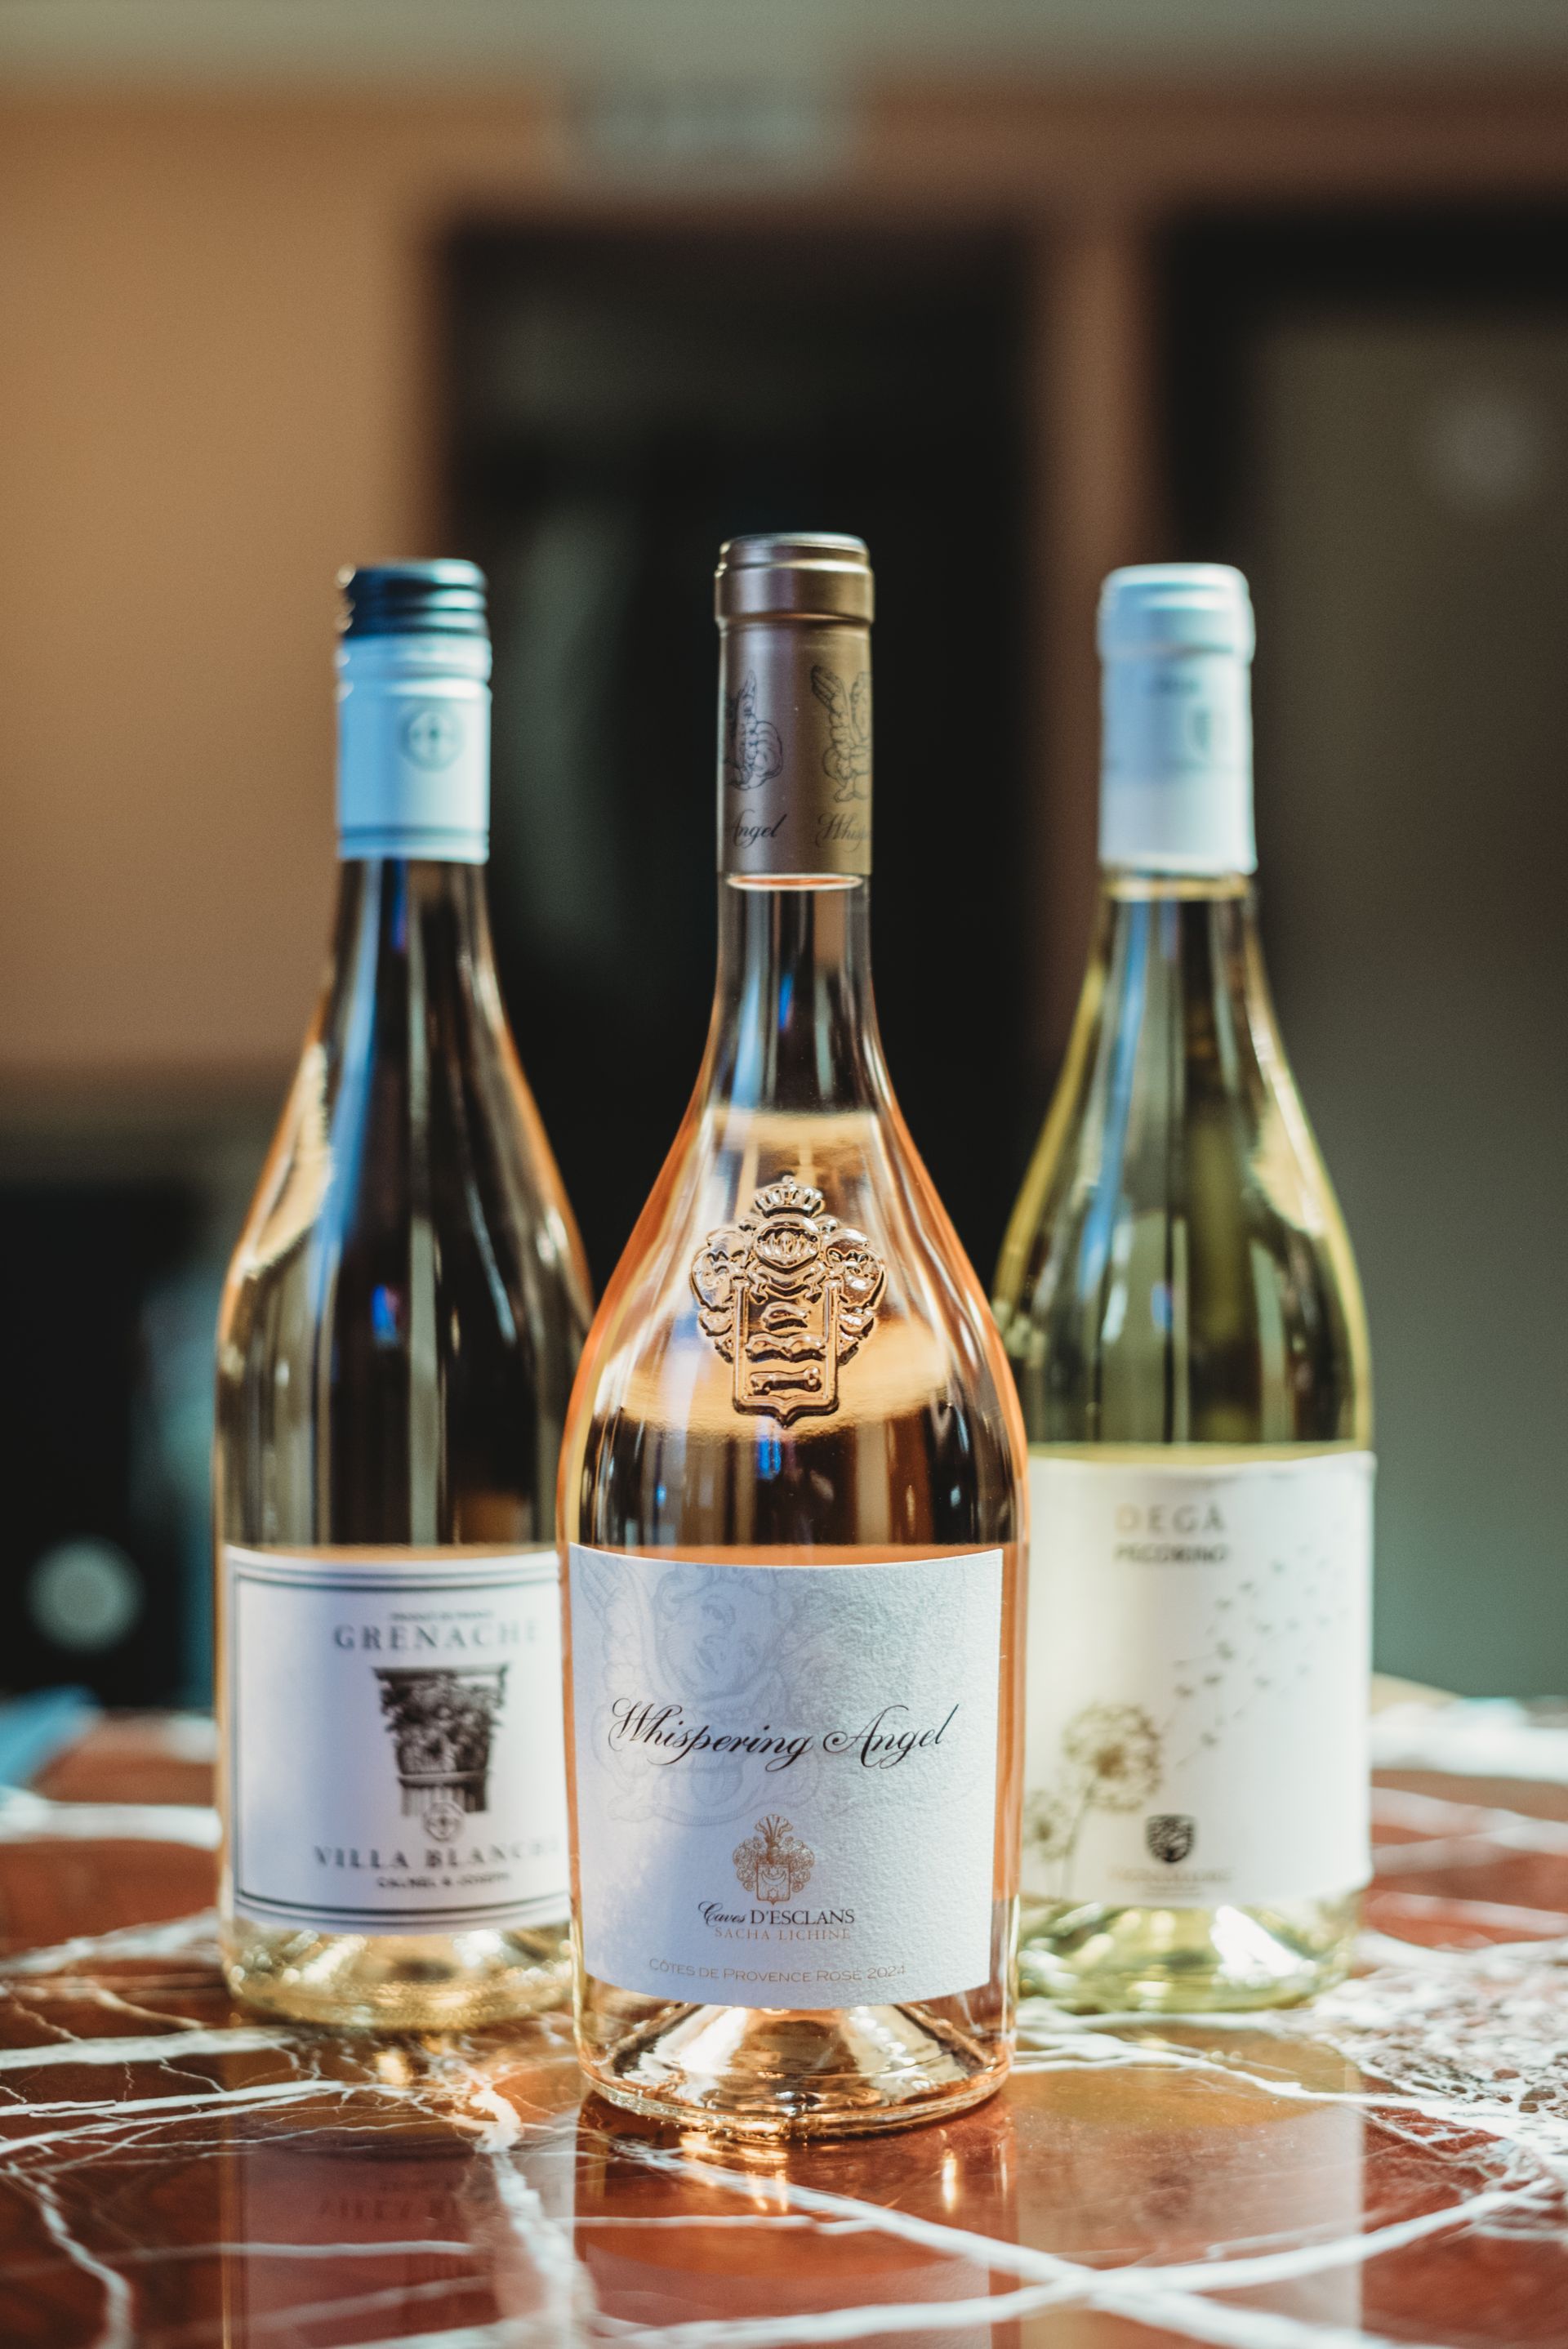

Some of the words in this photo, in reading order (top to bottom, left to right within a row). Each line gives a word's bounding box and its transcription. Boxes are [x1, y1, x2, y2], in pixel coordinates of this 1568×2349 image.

[608, 1697, 813, 1772] Whispering
[823, 1704, 960, 1769] Angel
[314, 1845, 410, 1868] VILLA
[697, 1901, 746, 1927] Caves
[751, 1908, 855, 1925] D'ESCLANS
[715, 1926, 770, 1941] SACHA
[779, 1928, 852, 1941] LICHINE
[648, 1958, 695, 1977] CÔTES
[698, 1967, 719, 1978] DE
[724, 1968, 812, 1983] PROVENCE
[817, 1967, 862, 1981] ROSÉ
[867, 1963, 906, 1980] 2024
